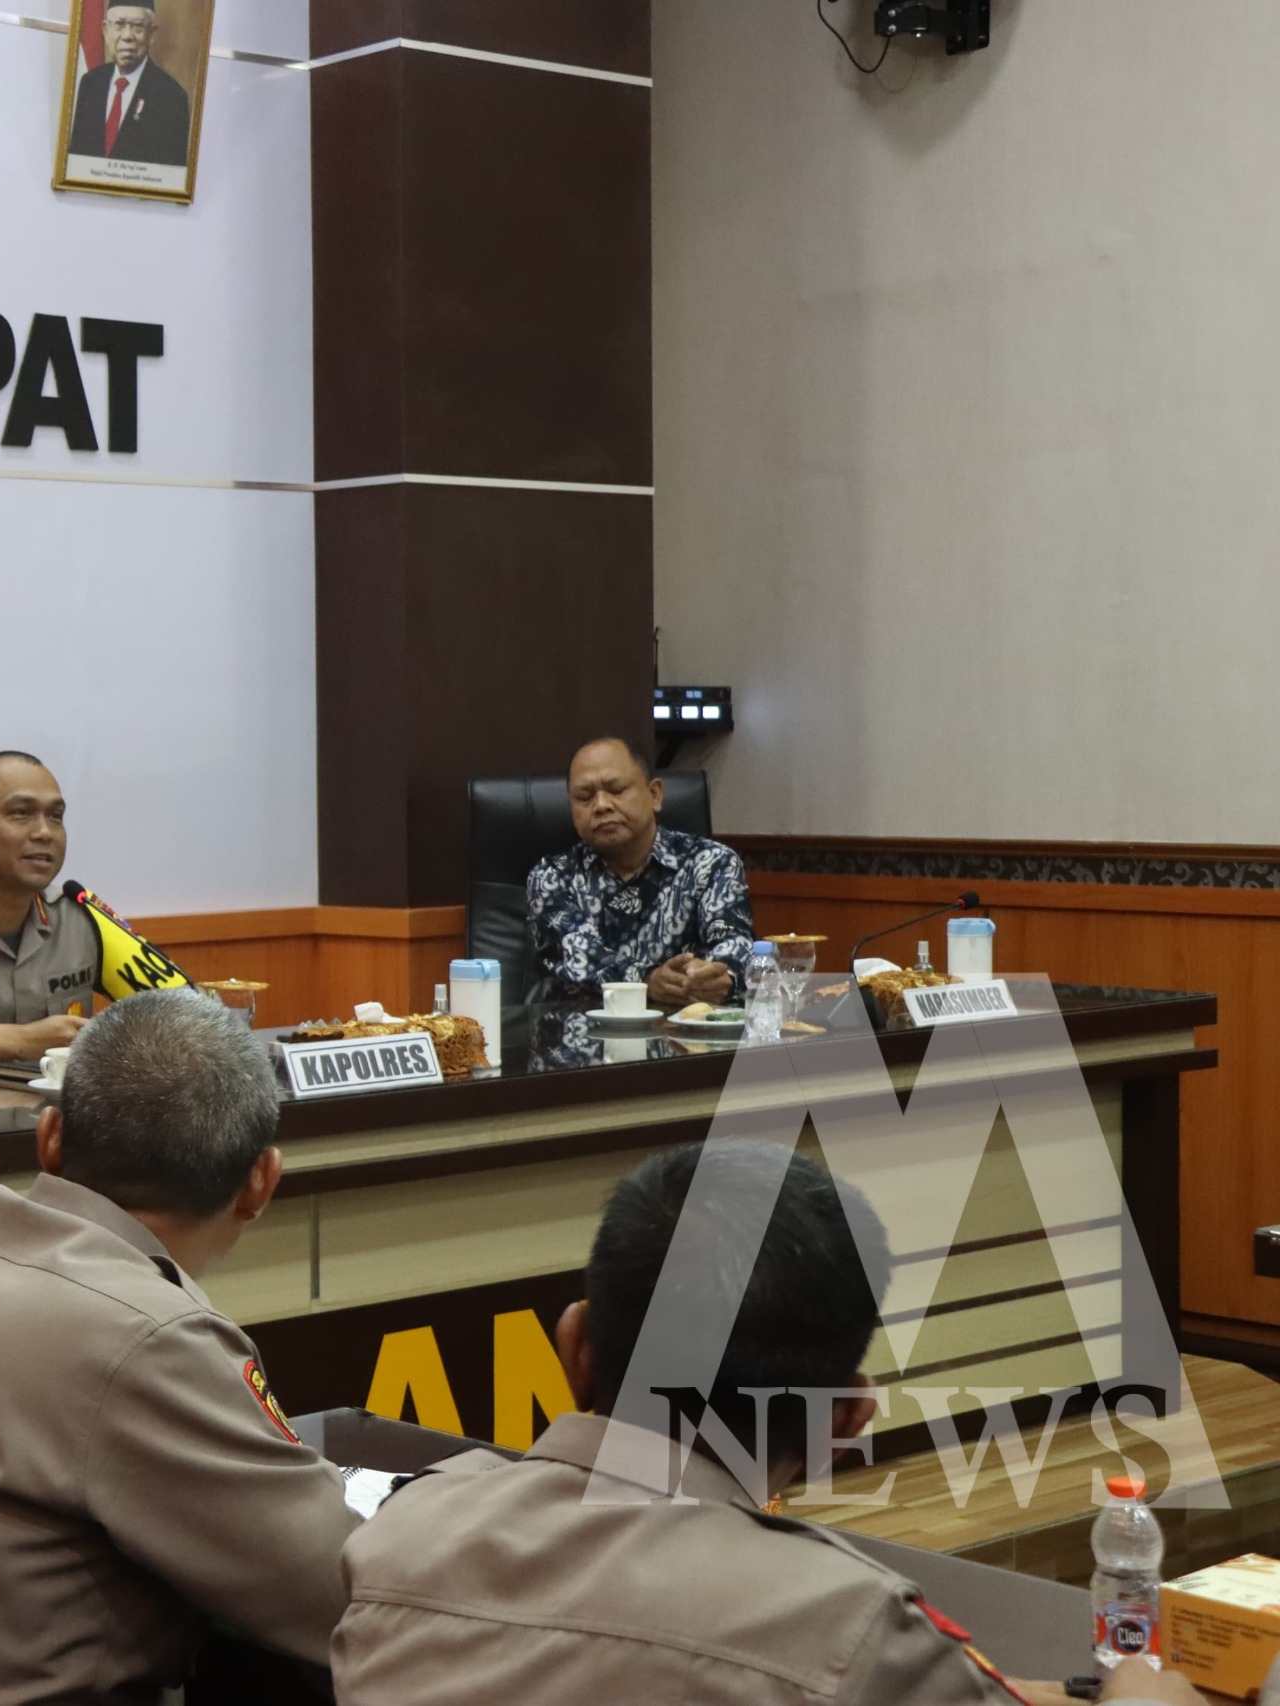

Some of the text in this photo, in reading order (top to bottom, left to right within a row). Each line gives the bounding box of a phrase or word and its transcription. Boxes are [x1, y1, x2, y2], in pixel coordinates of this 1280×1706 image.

[48, 968, 93, 994] POLRI
[915, 986, 1008, 1019] NARASUMBER
[300, 1044, 429, 1086] KAPOLRES
